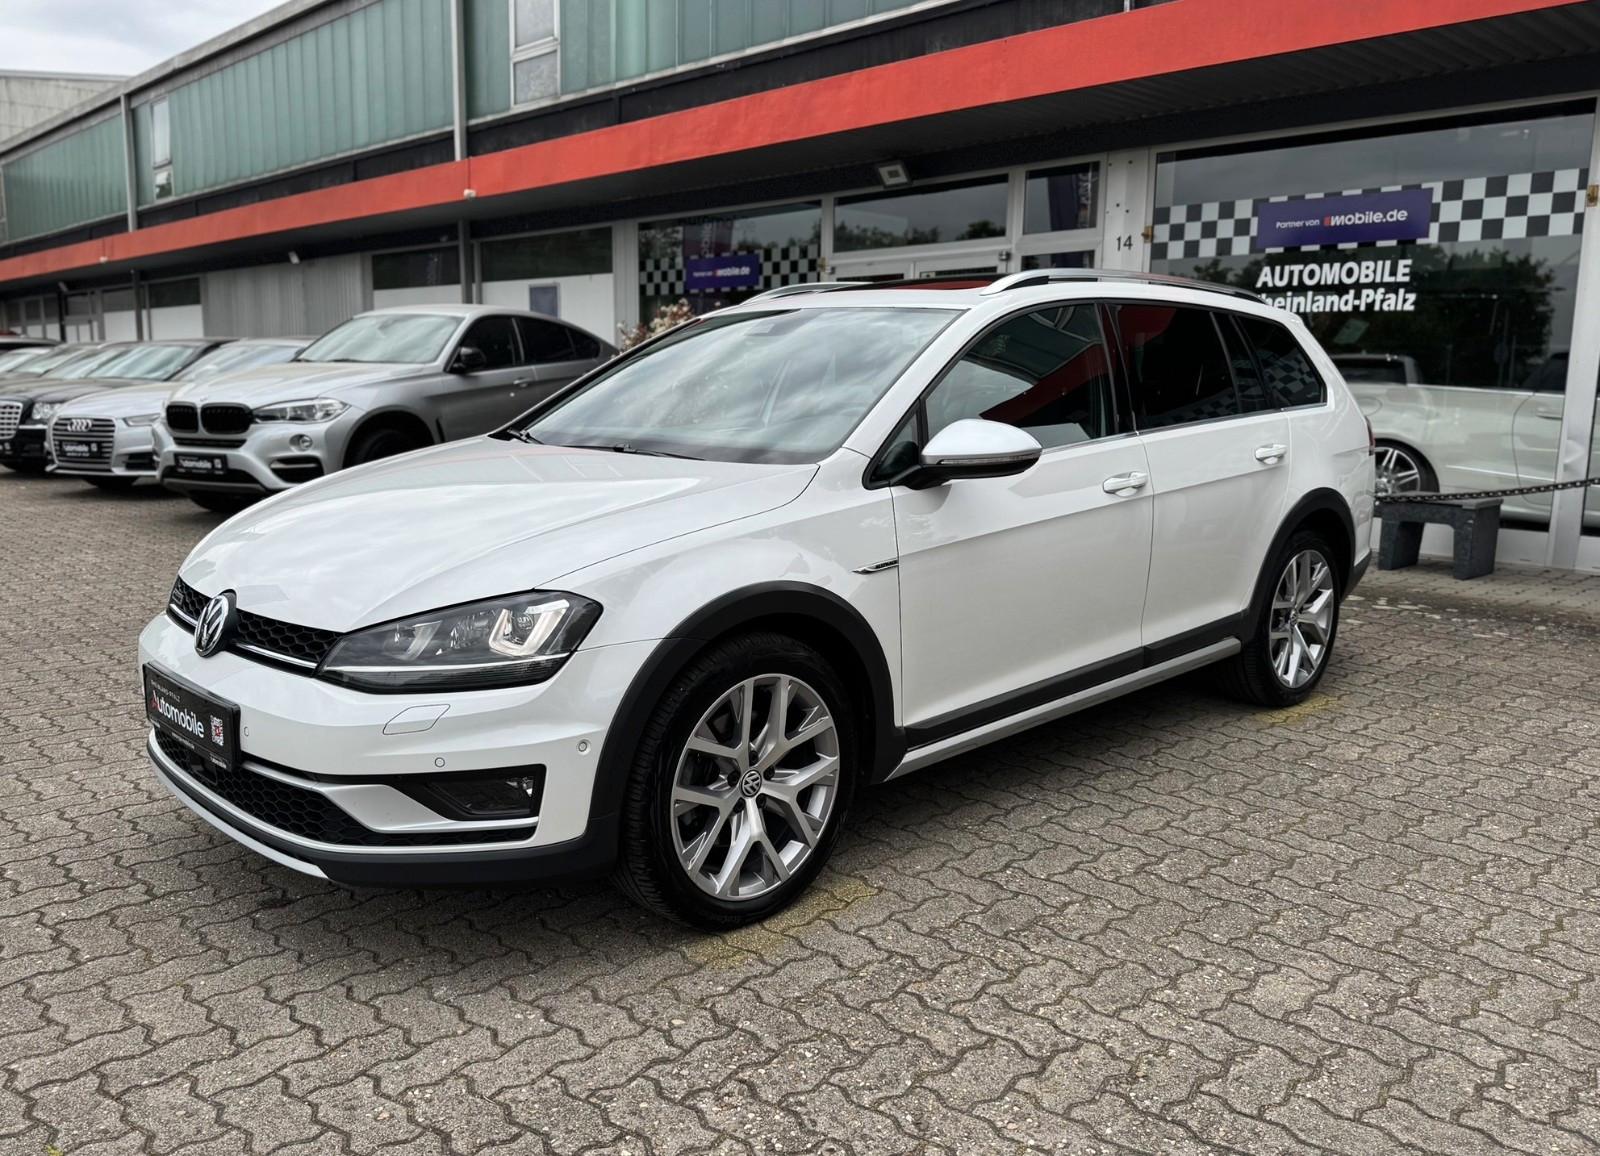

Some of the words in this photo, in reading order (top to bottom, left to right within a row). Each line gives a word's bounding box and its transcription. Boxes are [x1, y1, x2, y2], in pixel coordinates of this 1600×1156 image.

[1275, 219, 1305, 230] Partner
[1305, 218, 1320, 228] von
[1116, 235, 1133, 252] 14
[1256, 259, 1413, 288] AUTOMOBILE
[1258, 287, 1416, 315] heinland-Pfalz
[150, 690, 205, 738] Automobile
